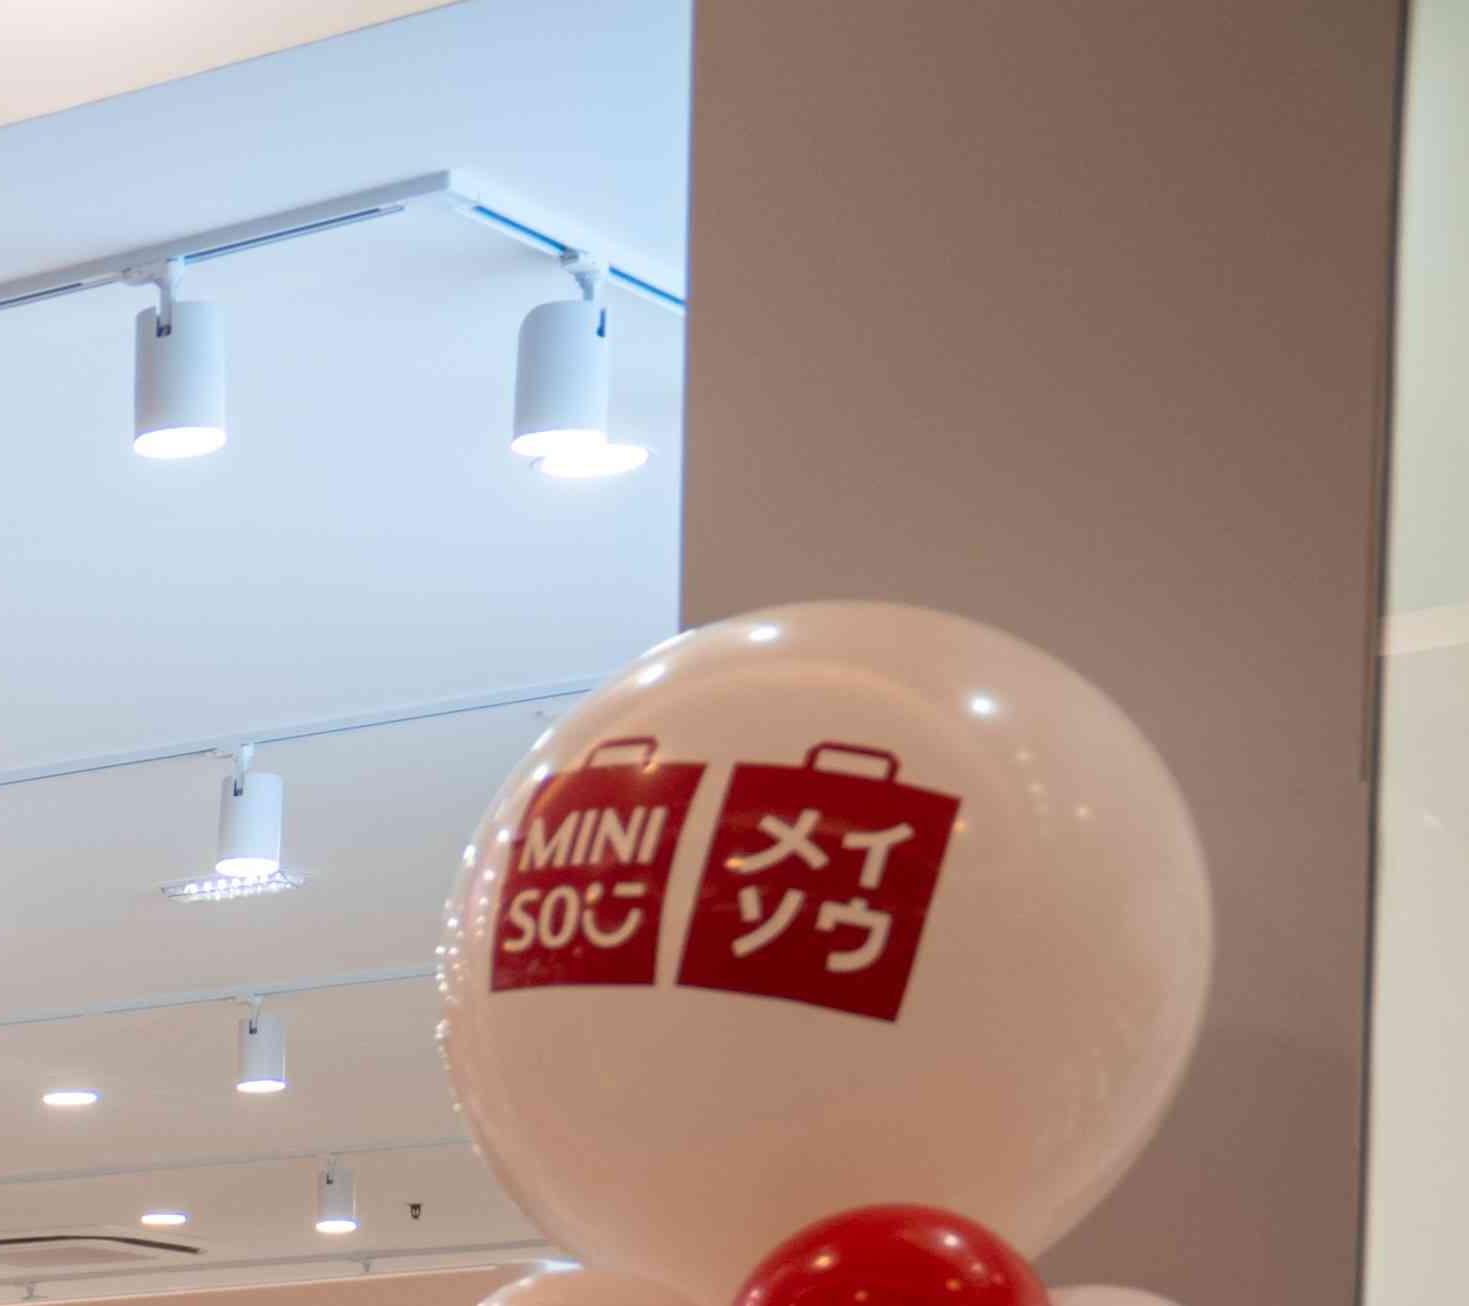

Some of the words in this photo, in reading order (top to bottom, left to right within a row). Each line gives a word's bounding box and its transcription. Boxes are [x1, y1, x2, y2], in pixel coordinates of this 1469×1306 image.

[518, 805, 669, 871] MINI
[725, 808, 914, 889] メイ
[730, 887, 893, 973] ソウ
